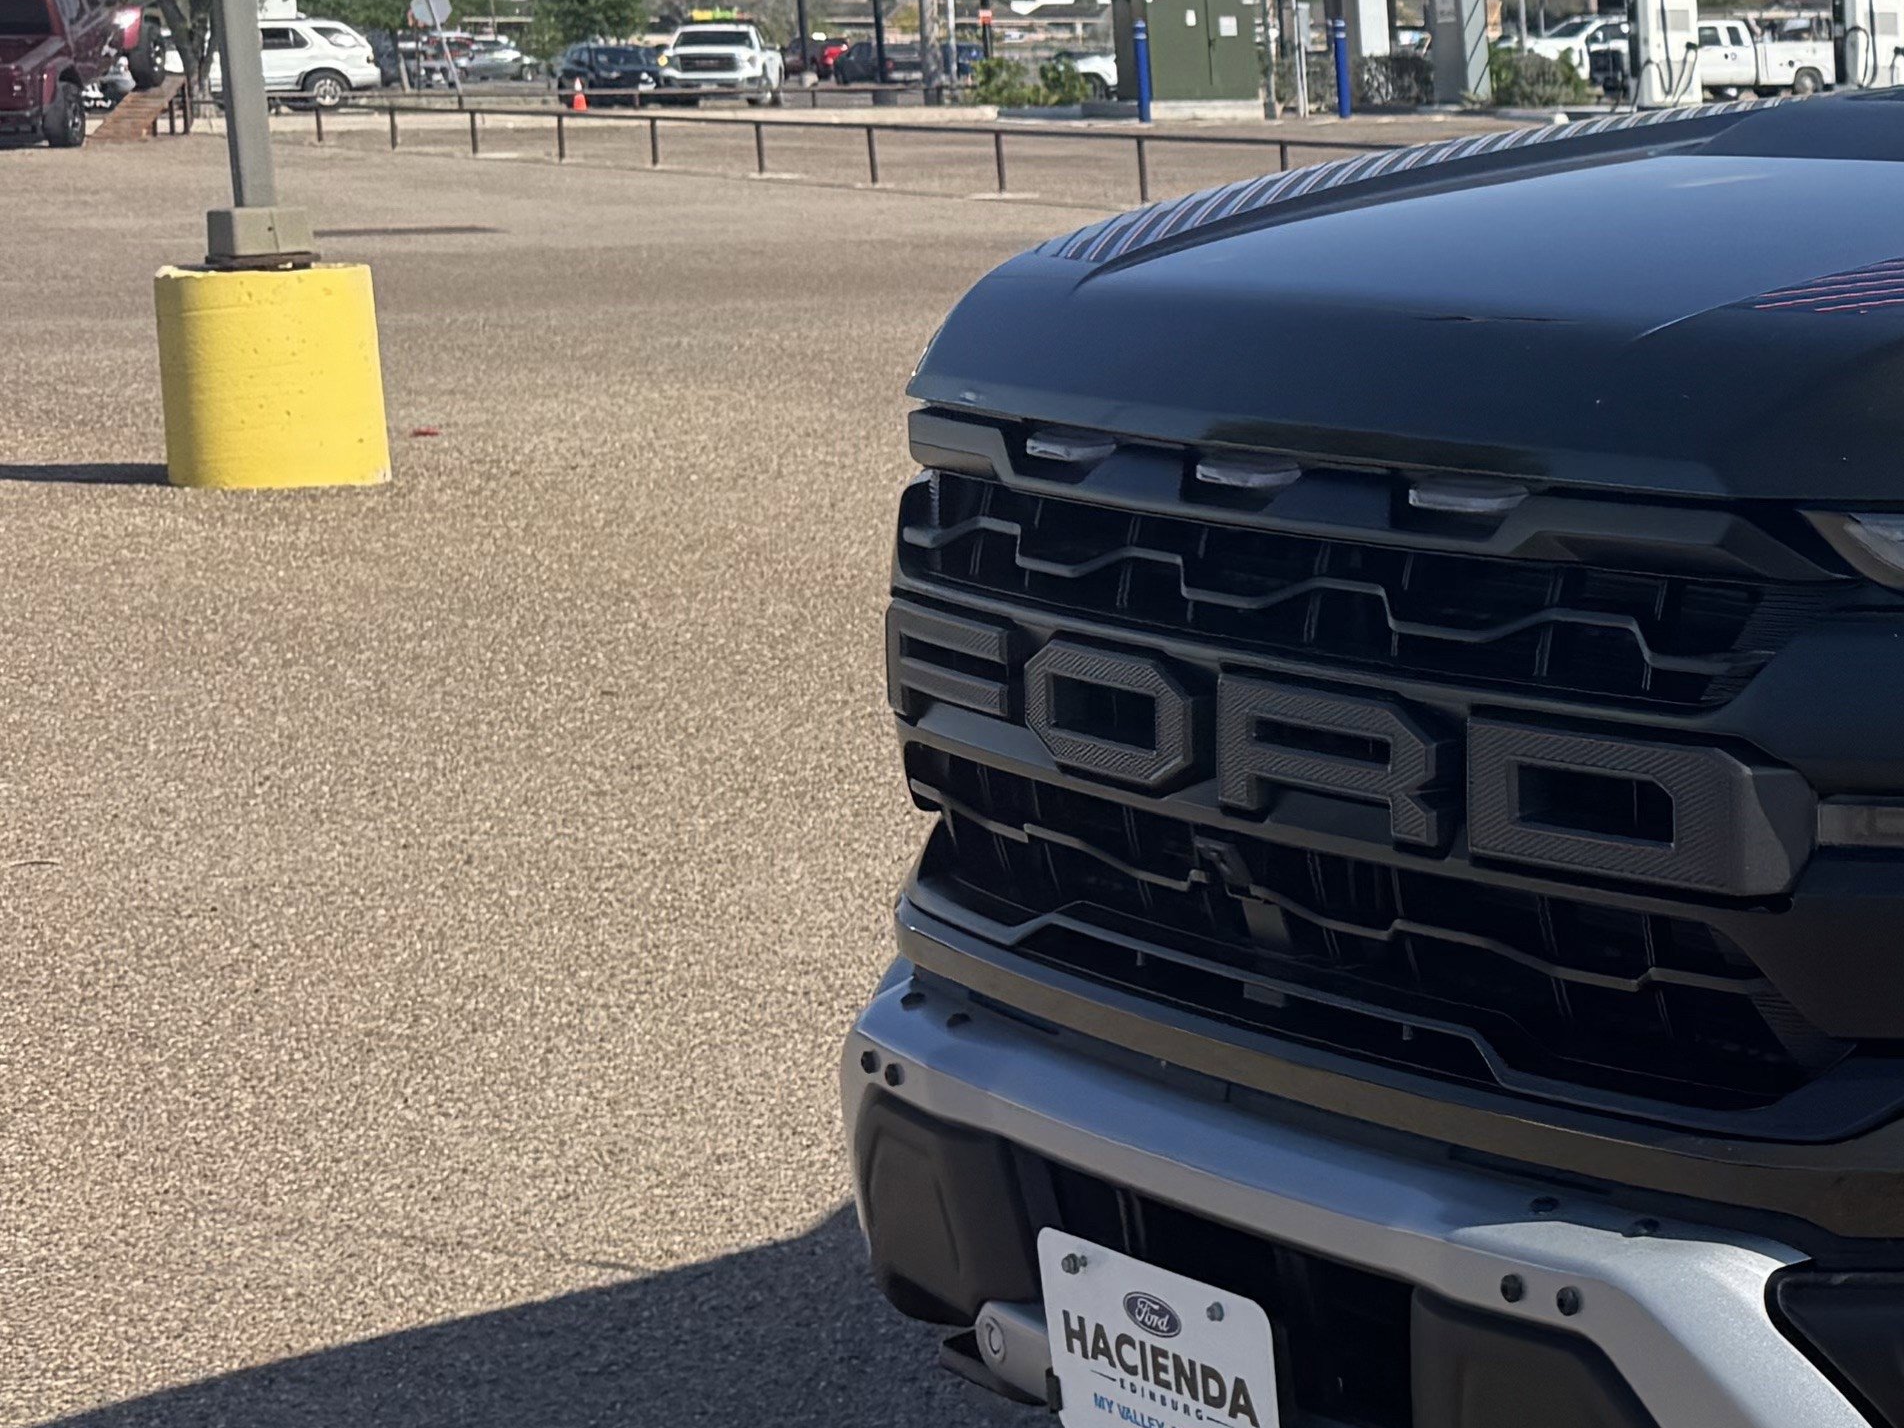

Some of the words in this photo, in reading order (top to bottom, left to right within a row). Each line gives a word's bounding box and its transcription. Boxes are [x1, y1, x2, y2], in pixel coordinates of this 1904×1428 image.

[886, 597, 1790, 897] FORD
[1133, 1297, 1171, 1333] Ford
[1062, 1309, 1261, 1428] HACIENDA
[1093, 1392, 1115, 1416] MY
[1119, 1377, 1204, 1421] EDINBURG
